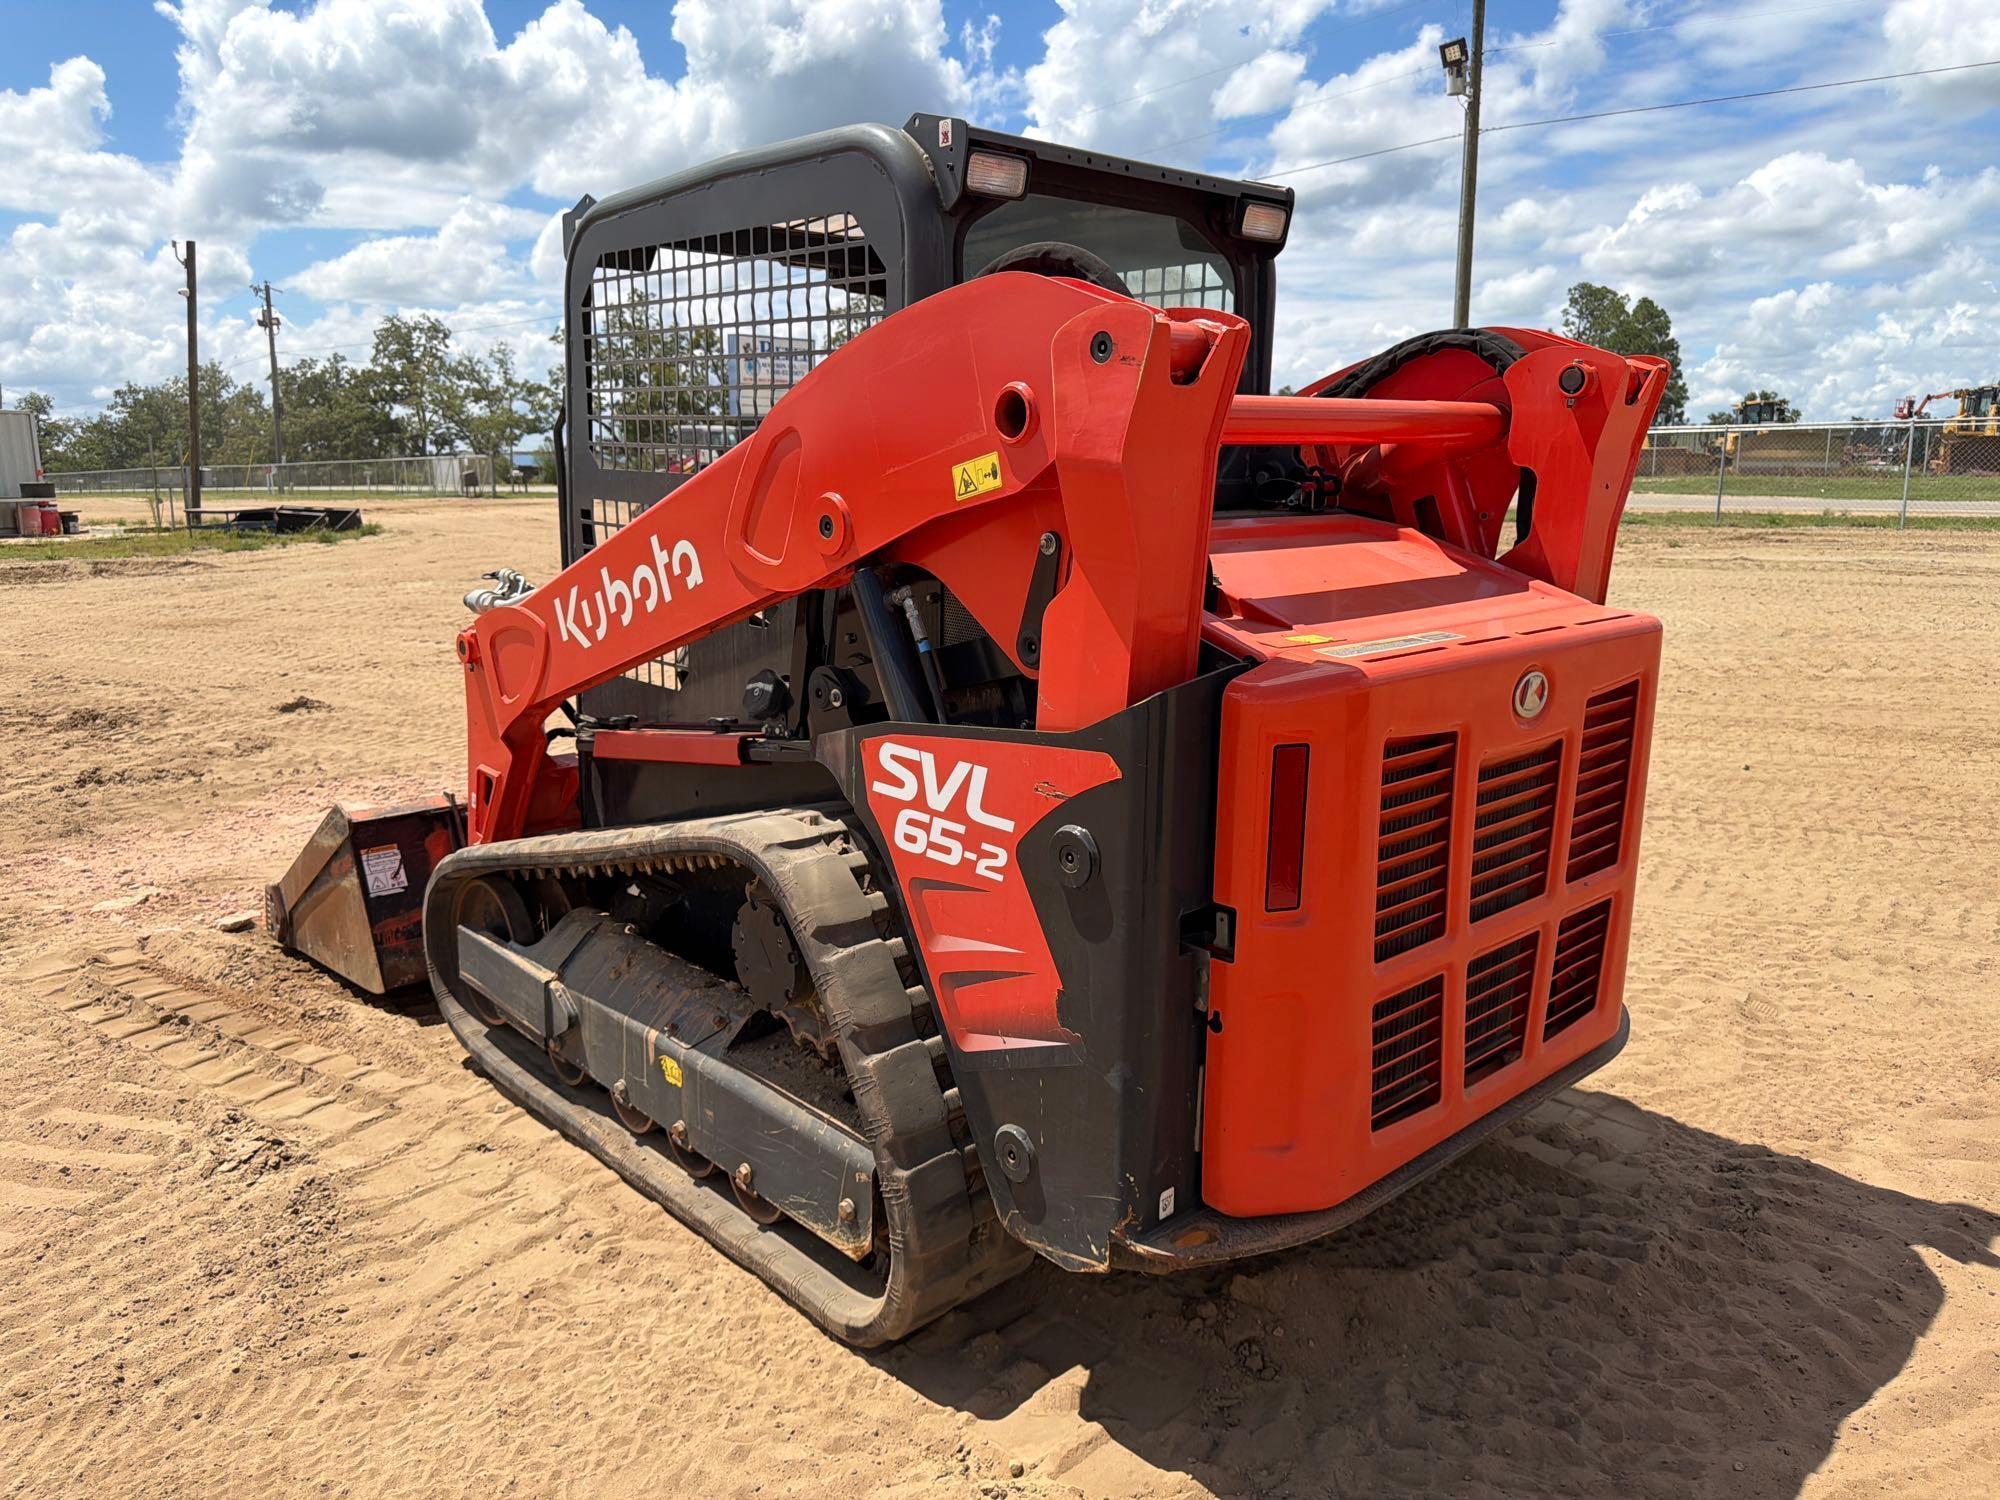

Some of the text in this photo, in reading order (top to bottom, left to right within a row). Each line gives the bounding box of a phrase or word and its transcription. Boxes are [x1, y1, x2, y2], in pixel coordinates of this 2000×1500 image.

[553, 534, 704, 649] Kubota
[872, 741, 1016, 834] SVL
[893, 808, 1008, 883] 65-2
